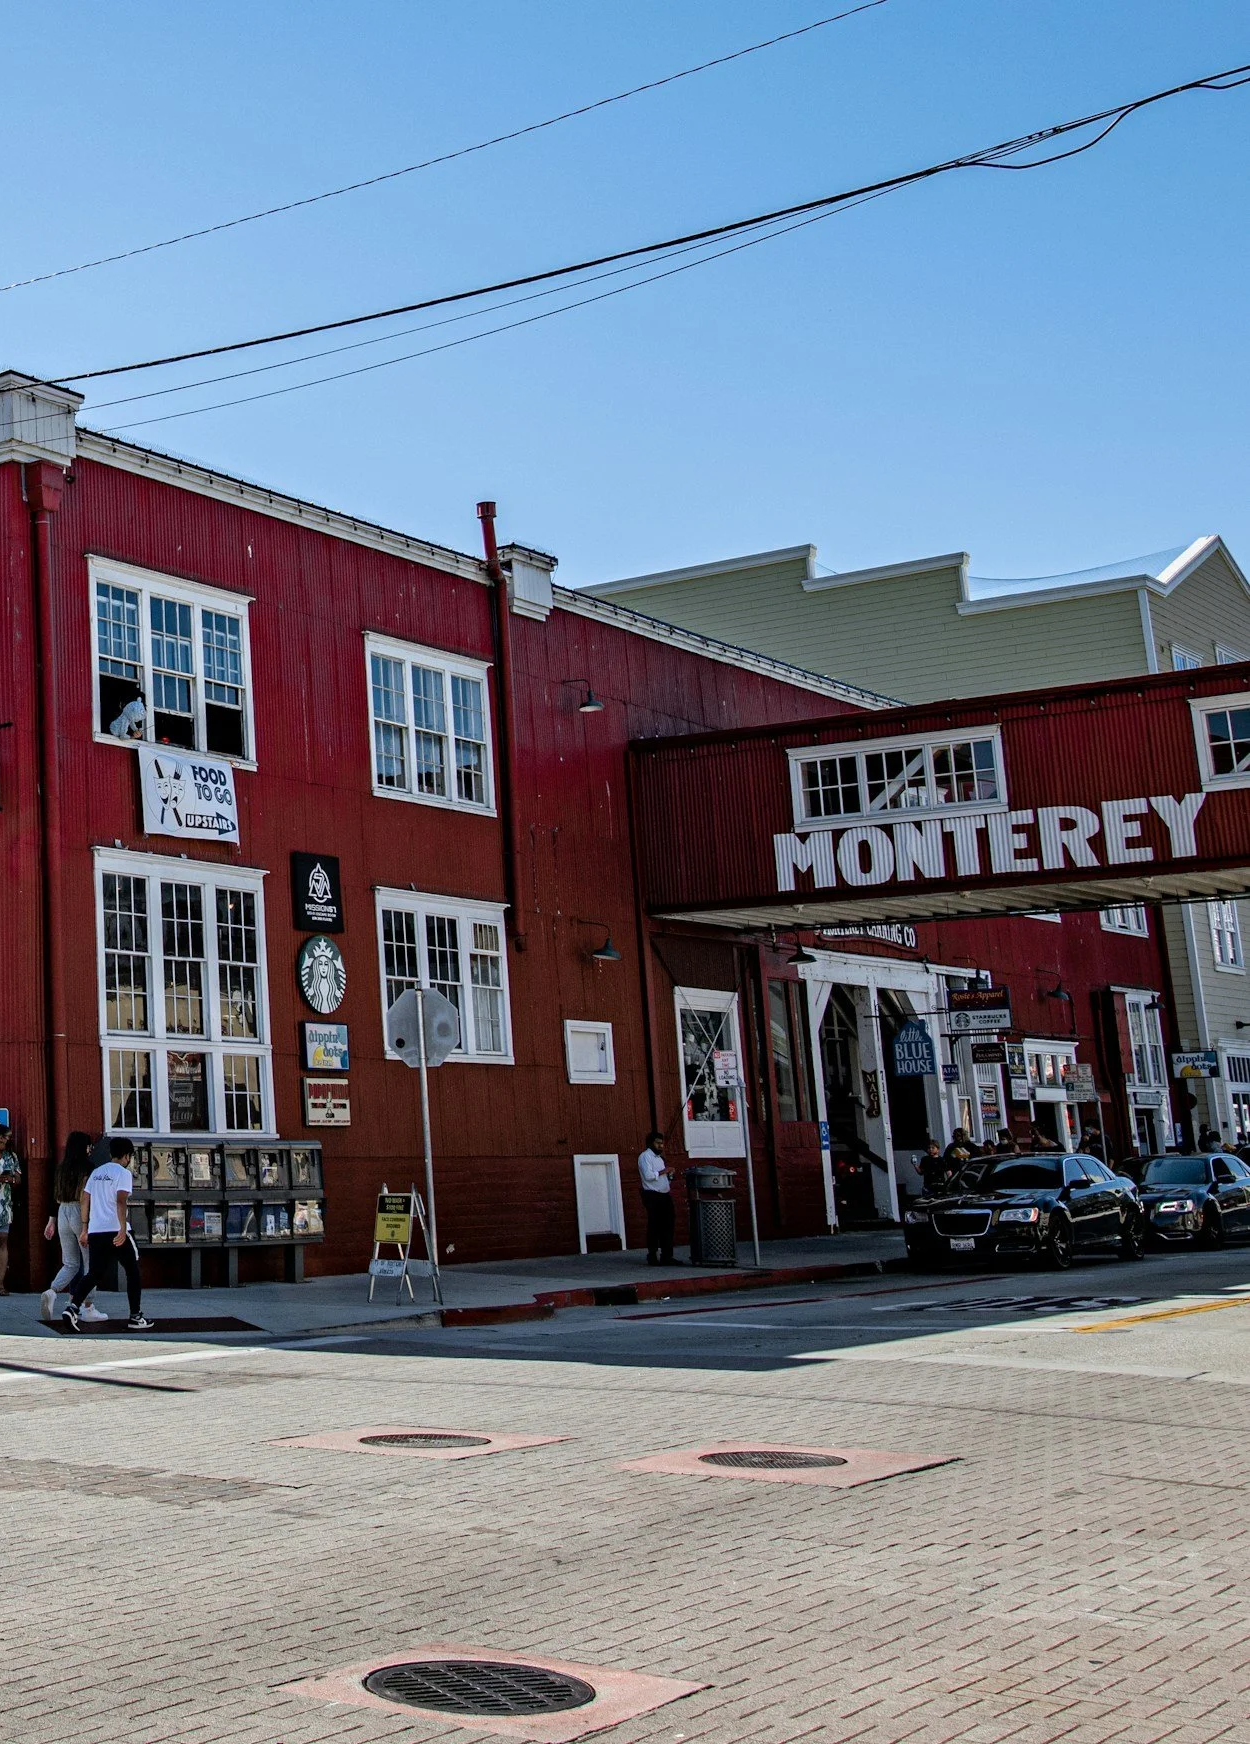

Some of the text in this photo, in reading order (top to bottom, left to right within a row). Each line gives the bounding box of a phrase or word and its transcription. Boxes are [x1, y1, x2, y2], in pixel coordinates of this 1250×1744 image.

[190, 764, 227, 786] FOOD
[194, 782, 233, 806] TO GO
[186, 814, 233, 830] UPSTAIRS
[773, 792, 1206, 892] MONTEREY
[904, 926, 916, 948] CO
[975, 990, 1003, 1000] Apparel
[900, 1026, 924, 1043] little
[322, 1044, 343, 1057] dots
[895, 1042, 932, 1060] BLUE
[897, 1058, 933, 1074] HOUSE
[866, 1074, 878, 1116] MAGIC
